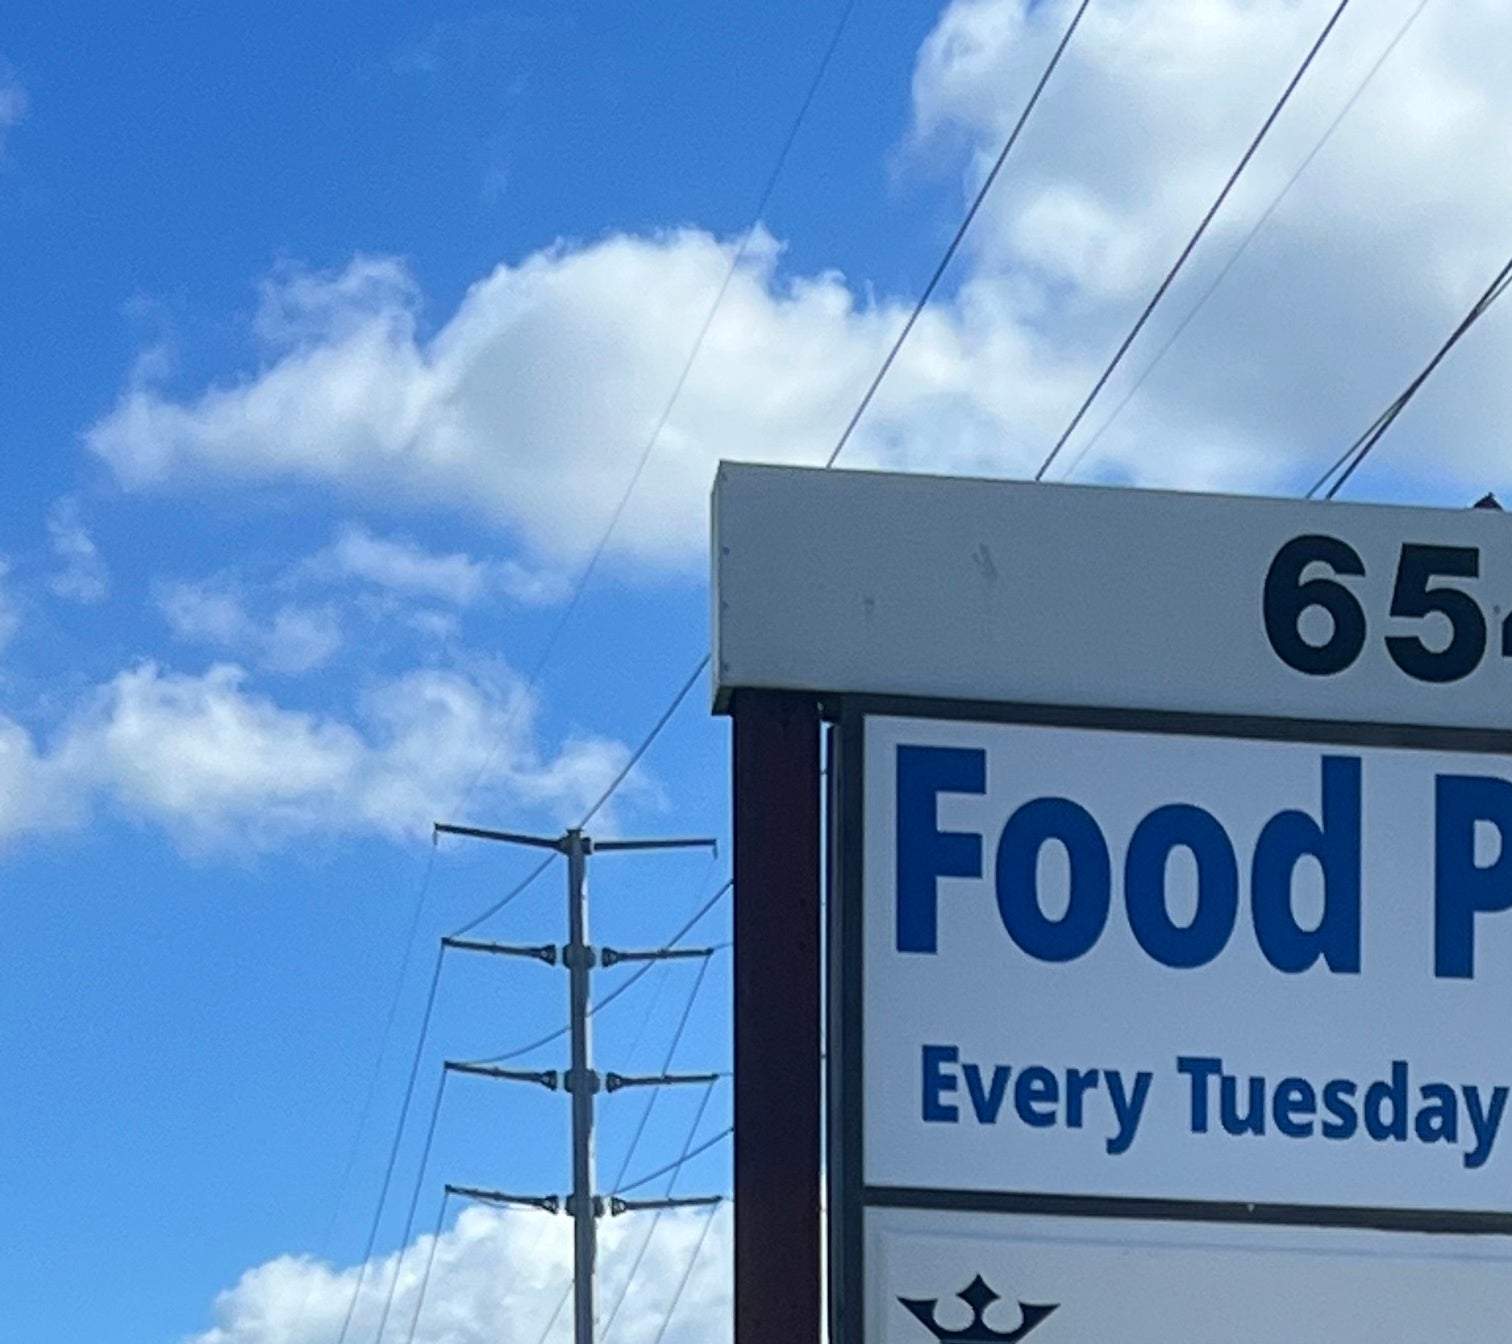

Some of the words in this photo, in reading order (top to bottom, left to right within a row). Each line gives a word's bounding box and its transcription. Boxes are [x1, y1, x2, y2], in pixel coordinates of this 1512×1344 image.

[895, 744, 1363, 975] Food
[920, 1044, 1153, 1155] Every
[1176, 1055, 1509, 1169] Tuesday
